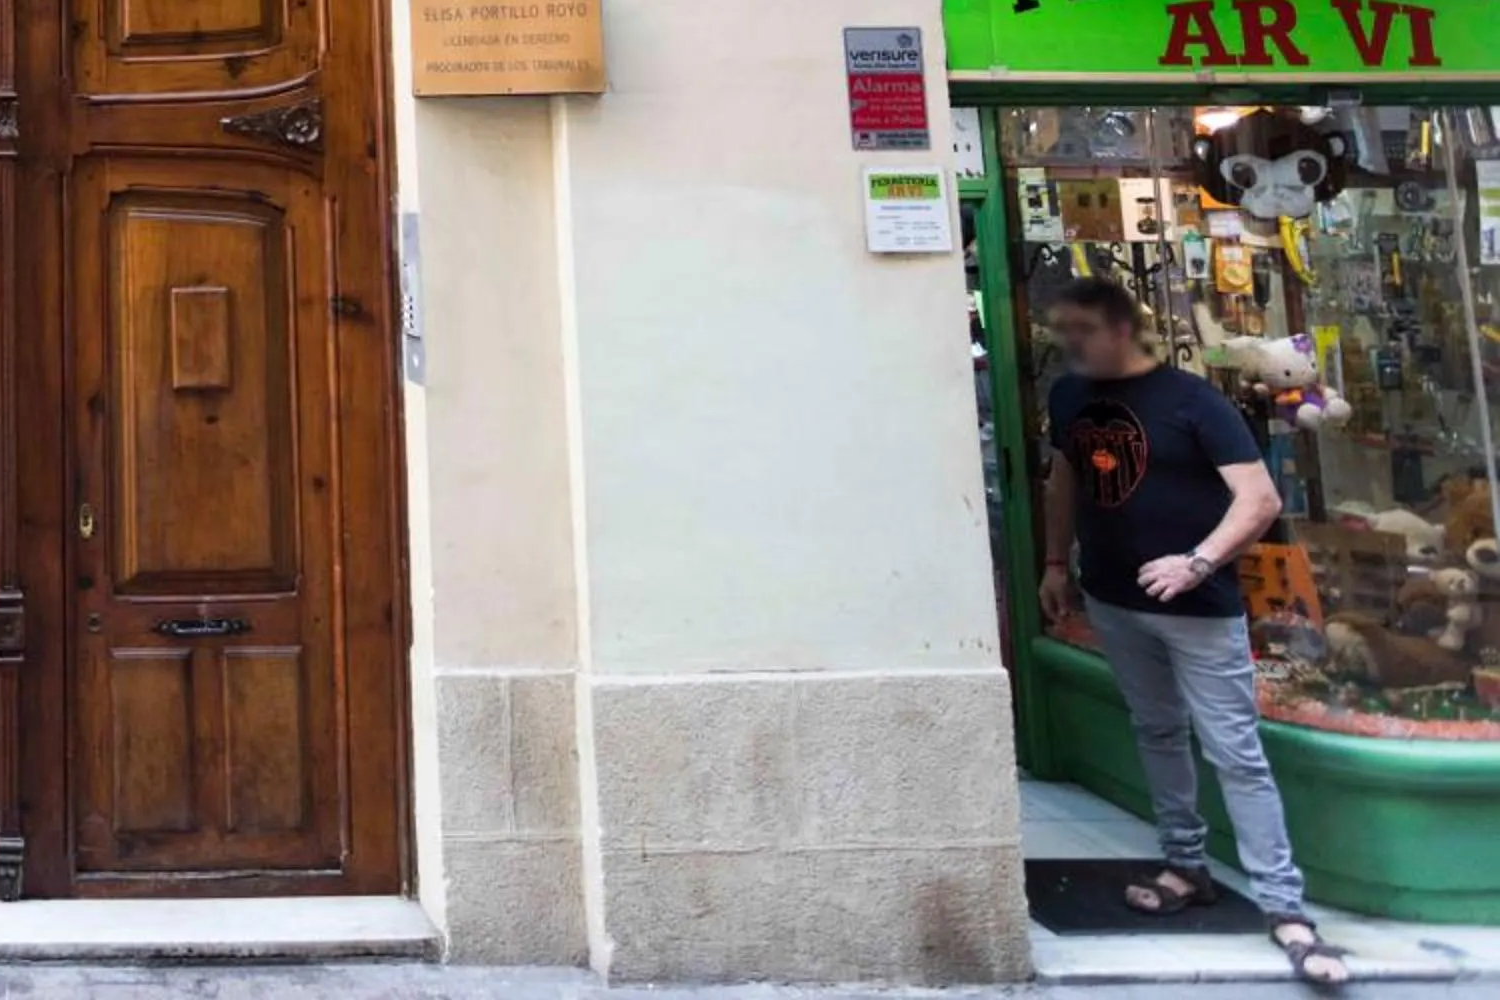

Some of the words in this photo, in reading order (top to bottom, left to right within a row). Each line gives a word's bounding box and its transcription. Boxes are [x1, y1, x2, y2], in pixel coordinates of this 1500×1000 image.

[423, 7, 463, 23] ELISA
[469, 4, 539, 21] PORTILLO
[546, 2, 588, 18] ROYO
[850, 49, 919, 62] verisure
[851, 77, 922, 93] Alarma
